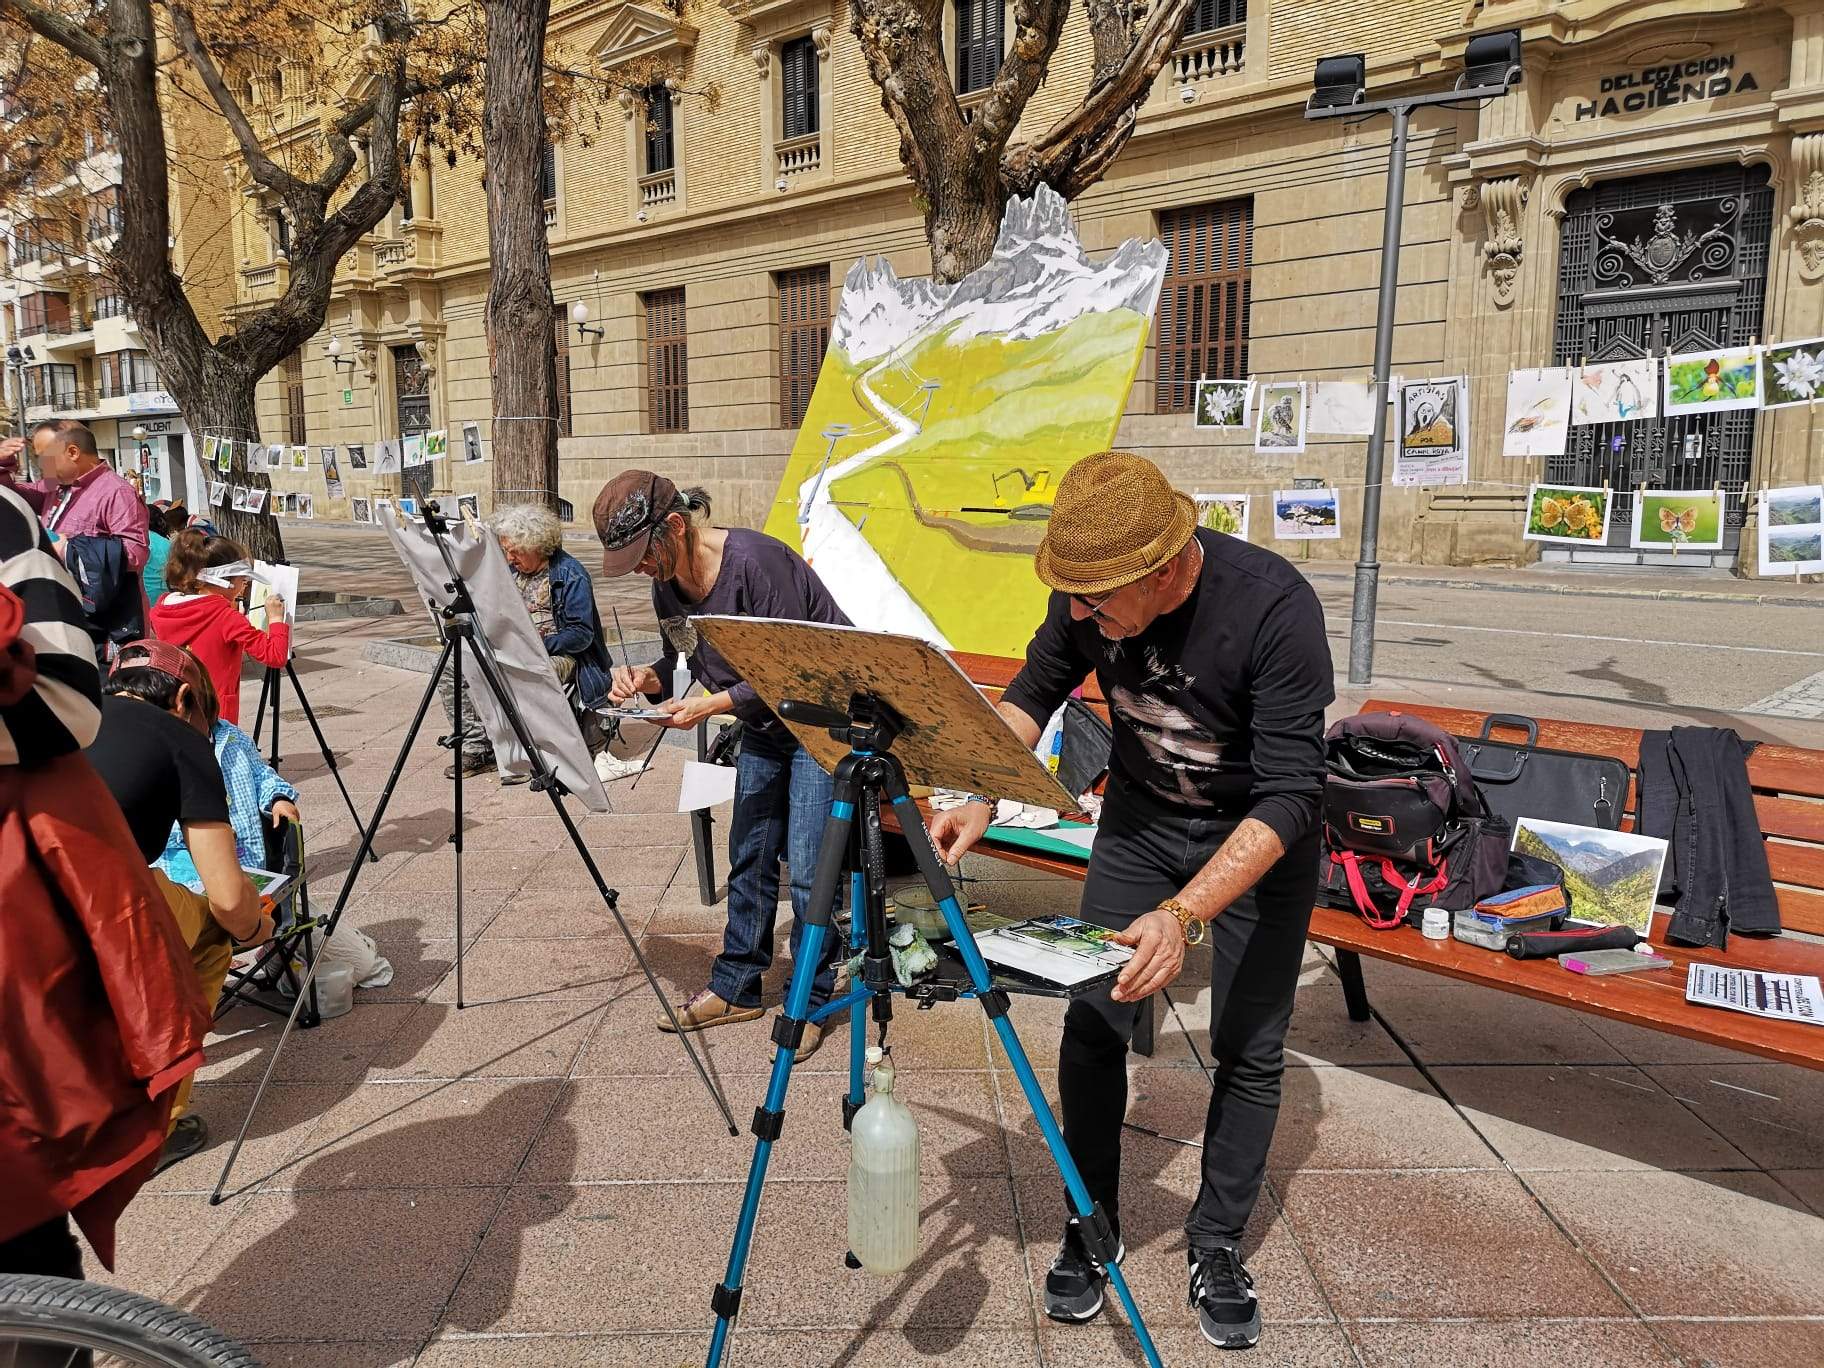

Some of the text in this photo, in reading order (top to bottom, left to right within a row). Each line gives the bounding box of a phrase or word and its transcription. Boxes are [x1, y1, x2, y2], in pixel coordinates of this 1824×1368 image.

[1600, 55, 1735, 93] DELEGACION
[1576, 72, 1758, 121] HACIENDA
[1408, 386, 1446, 403] ARTISTAS
